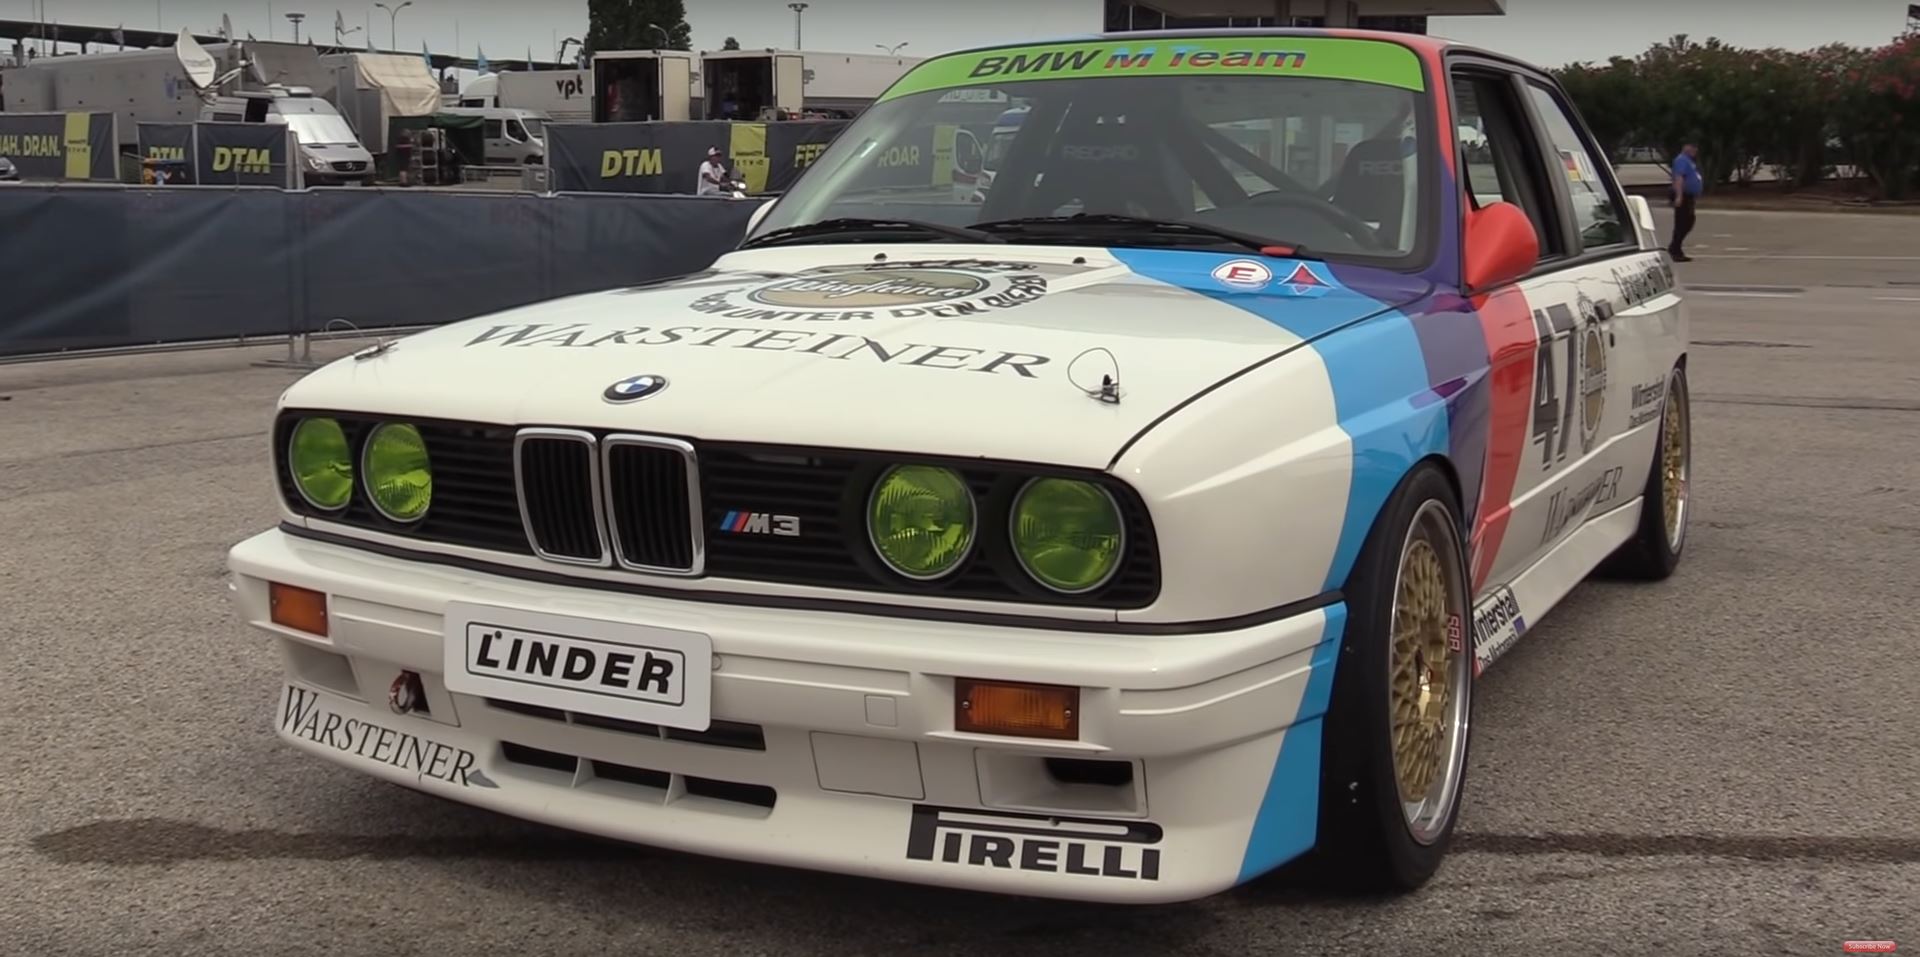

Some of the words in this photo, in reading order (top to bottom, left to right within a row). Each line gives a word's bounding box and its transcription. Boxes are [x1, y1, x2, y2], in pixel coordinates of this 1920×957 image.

[968, 49, 1104, 79] BMW
[1104, 46, 1156, 69] M
[1167, 45, 1307, 69] Team
[556, 74, 584, 99] vpt
[0, 134, 21, 155] AH.
[23, 134, 61, 156] DRAN.
[877, 145, 920, 168] ROAR
[213, 146, 271, 174] DTM
[601, 148, 664, 178] DTM
[1226, 266, 1257, 282] E
[722, 308, 875, 321] UNTER
[464, 323, 1051, 379] WARSTEINER
[1532, 302, 1577, 471] 47
[742, 512, 800, 537] M3
[476, 634, 674, 695] LINDER
[281, 685, 475, 787] WARSTEINER
[906, 803, 1164, 881] PIRELLI
